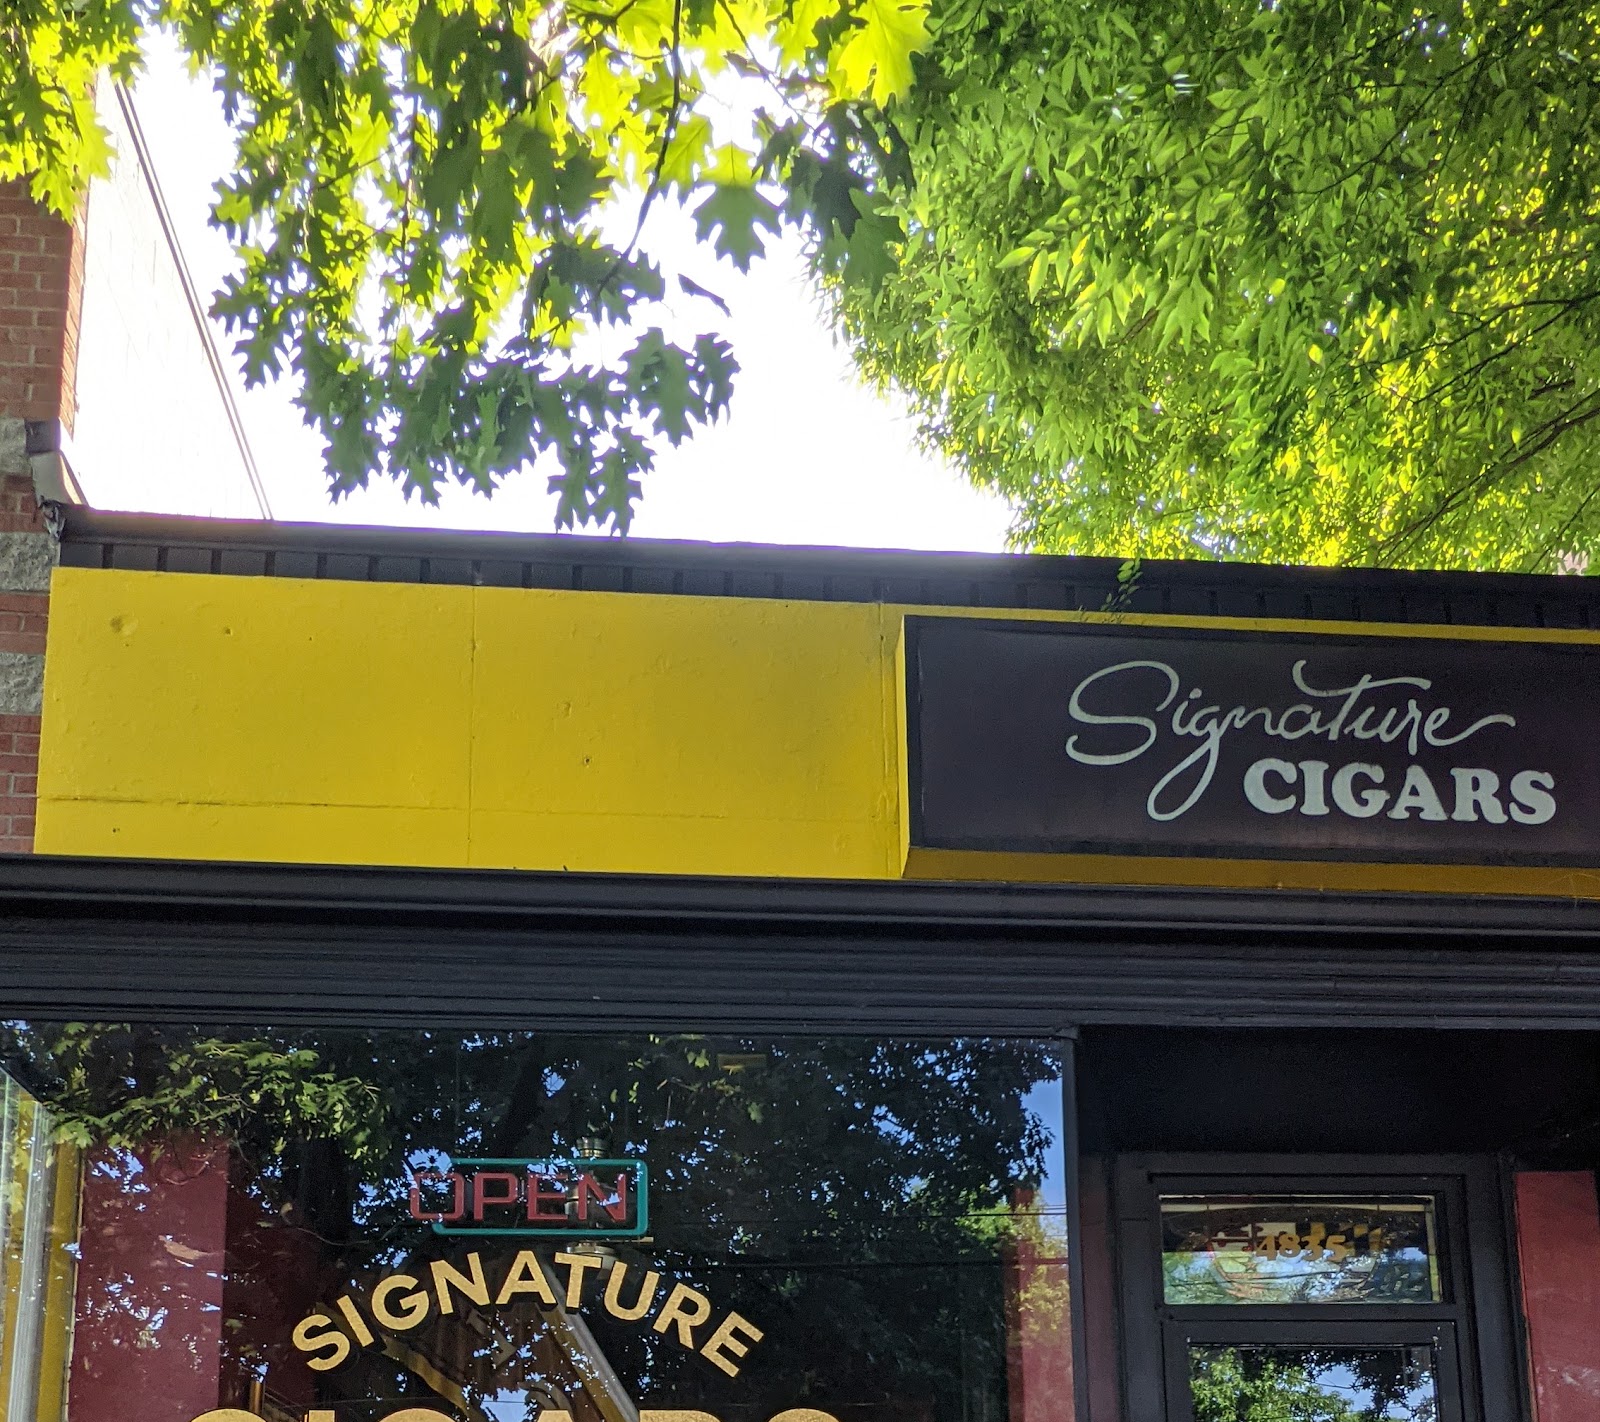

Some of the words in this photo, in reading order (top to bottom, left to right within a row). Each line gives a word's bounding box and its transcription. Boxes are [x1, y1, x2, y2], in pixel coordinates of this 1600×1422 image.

[1066, 660, 1515, 821] Signature
[1243, 758, 1556, 825] CIGARS
[410, 1170, 629, 1221] OPEN
[1255, 1233, 1346, 1262] 4835
[292, 1250, 764, 1377] SIGNATURE
